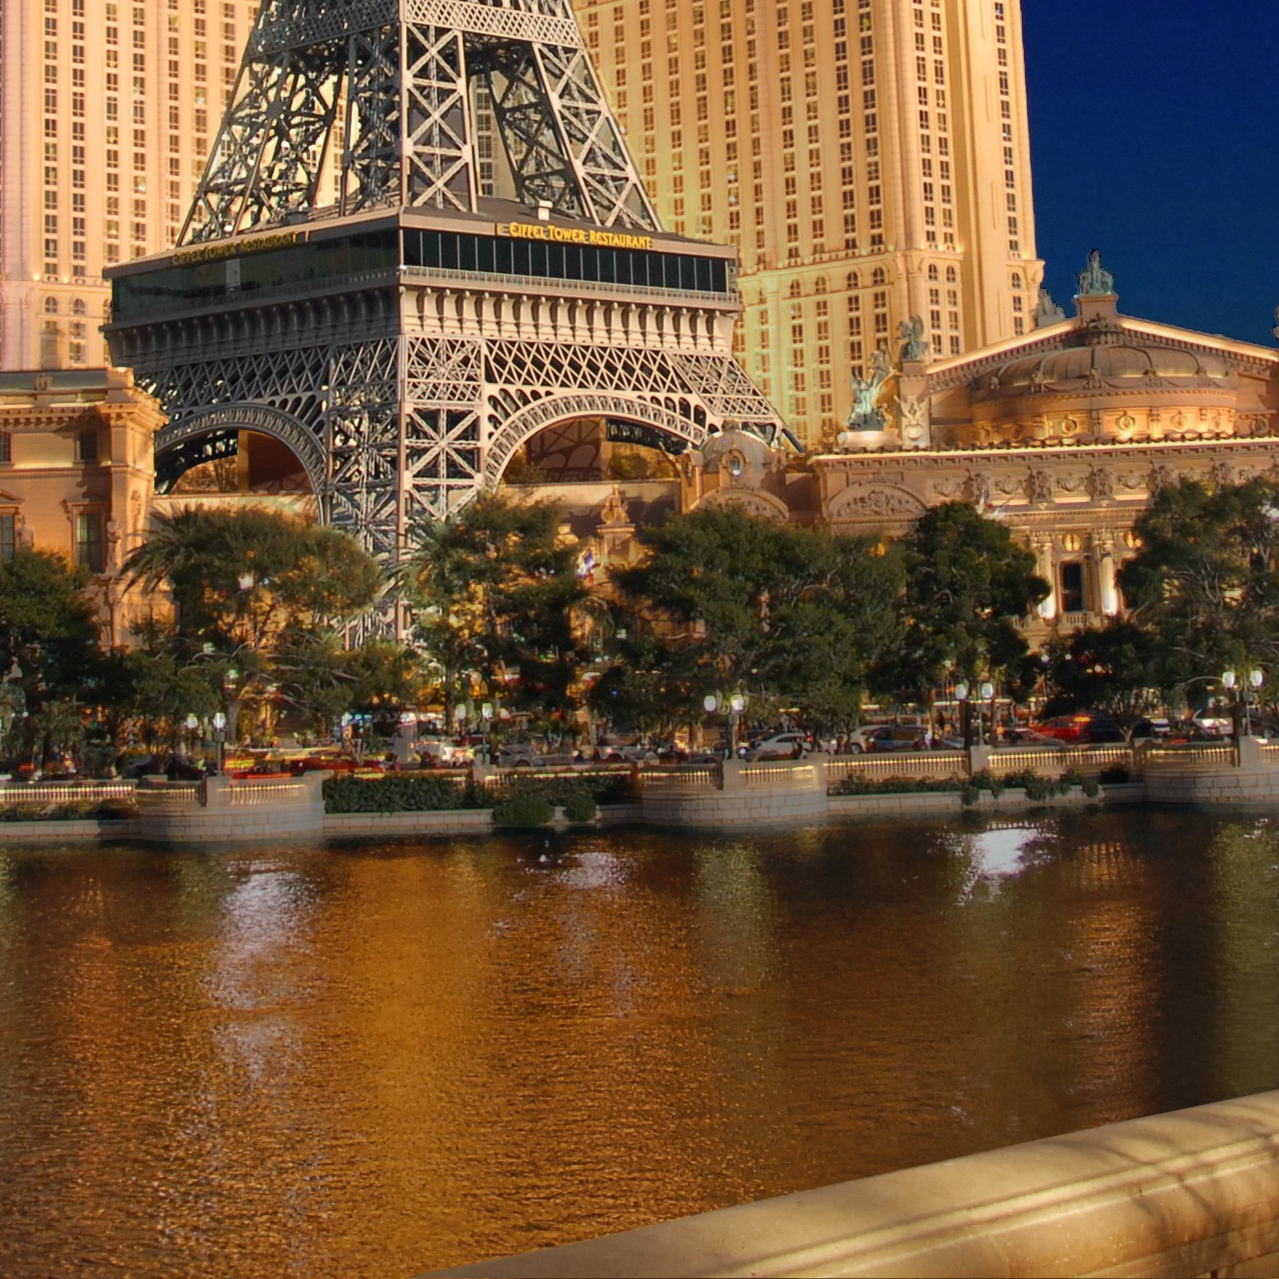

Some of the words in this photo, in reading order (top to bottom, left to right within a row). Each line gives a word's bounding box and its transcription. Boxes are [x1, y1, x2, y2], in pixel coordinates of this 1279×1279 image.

[240, 230, 299, 253] RESTAURANT
[509, 222, 545, 238] EIFFEL
[548, 225, 585, 243] TOWER
[589, 230, 652, 249] RESTAURANT
